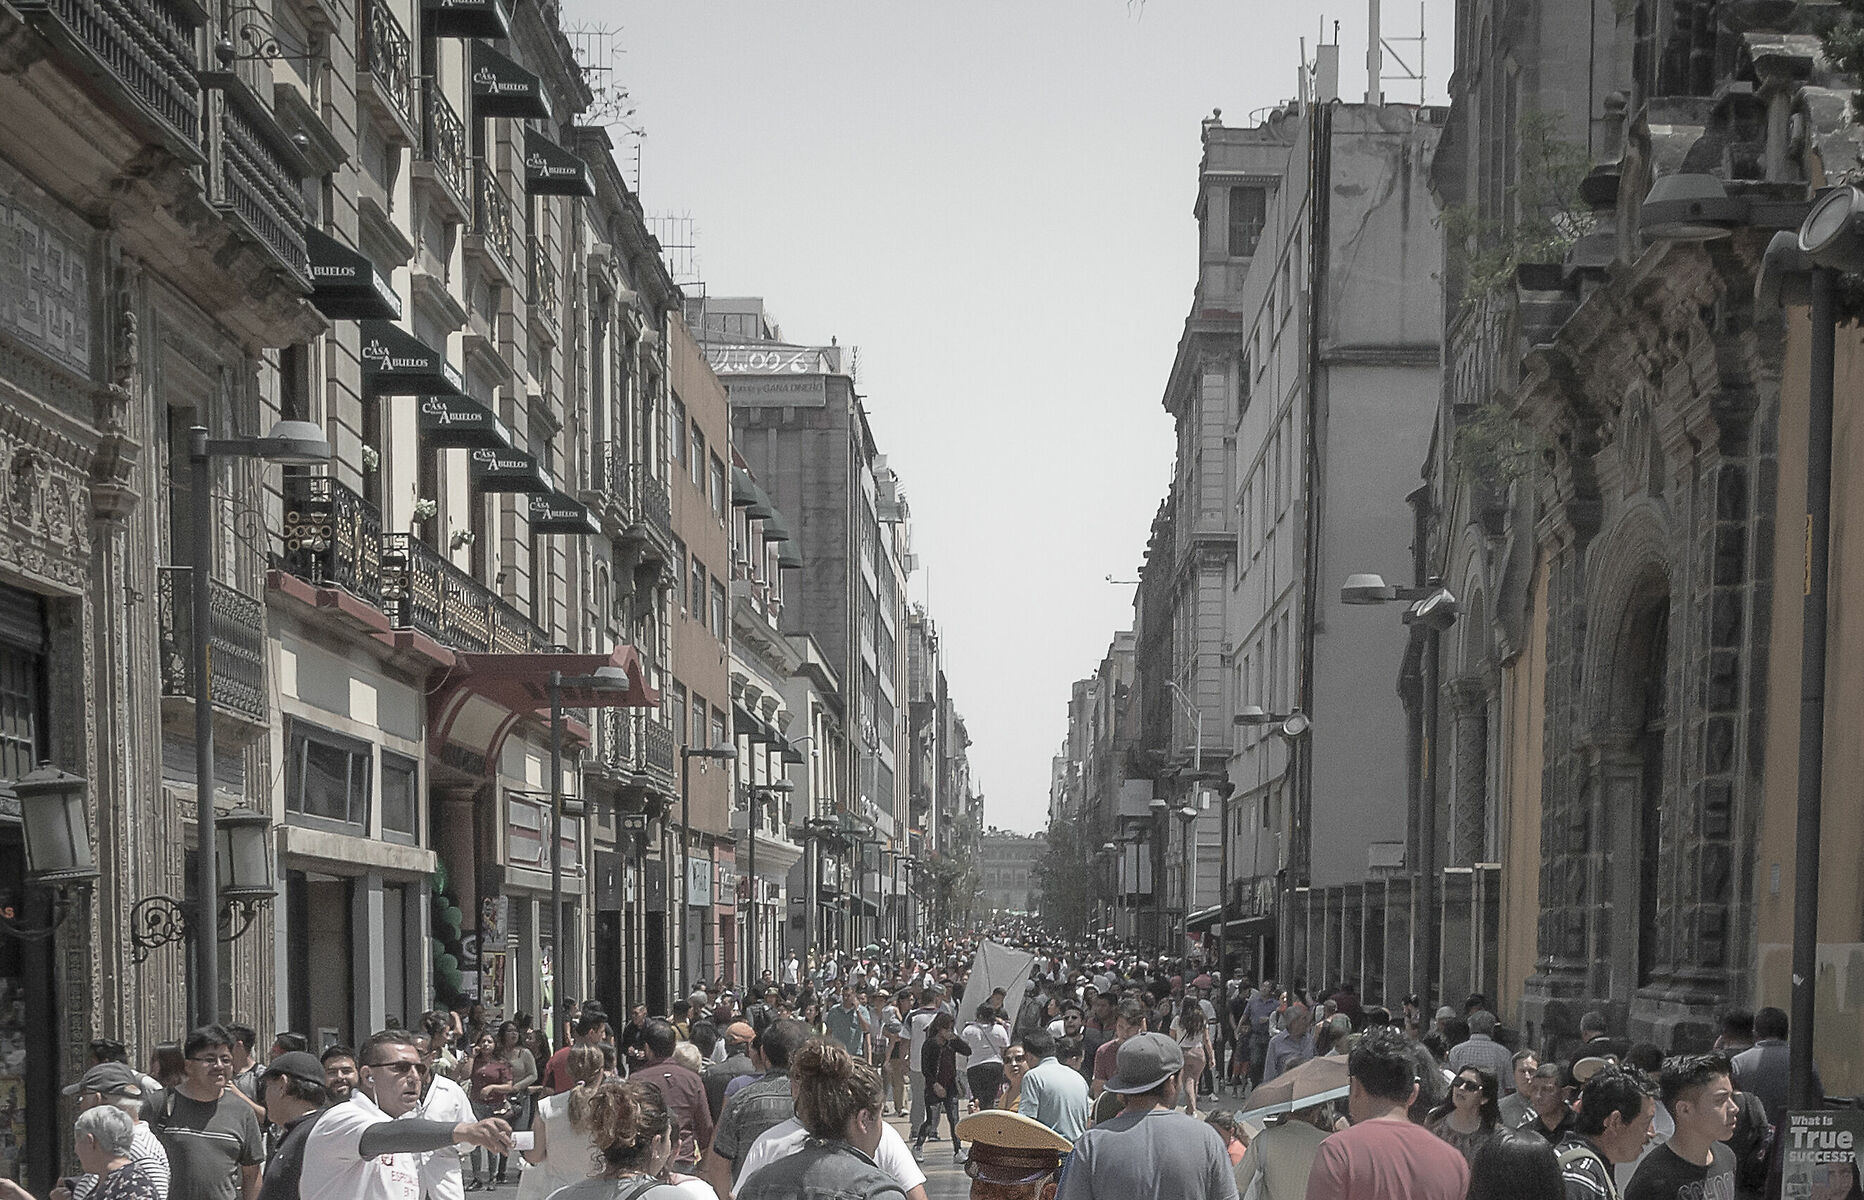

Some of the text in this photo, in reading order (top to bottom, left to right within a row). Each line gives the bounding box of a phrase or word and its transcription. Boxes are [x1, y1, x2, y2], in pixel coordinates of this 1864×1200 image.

[362, 347, 390, 358] CASA
[380, 355, 429, 370] ABUELOS
[438, 411, 482, 424] ABUELOS
[1791, 1115, 1820, 1126] What
[1790, 1126, 1853, 1149] True
[1789, 1150, 1856, 1163] SUCCESS?
